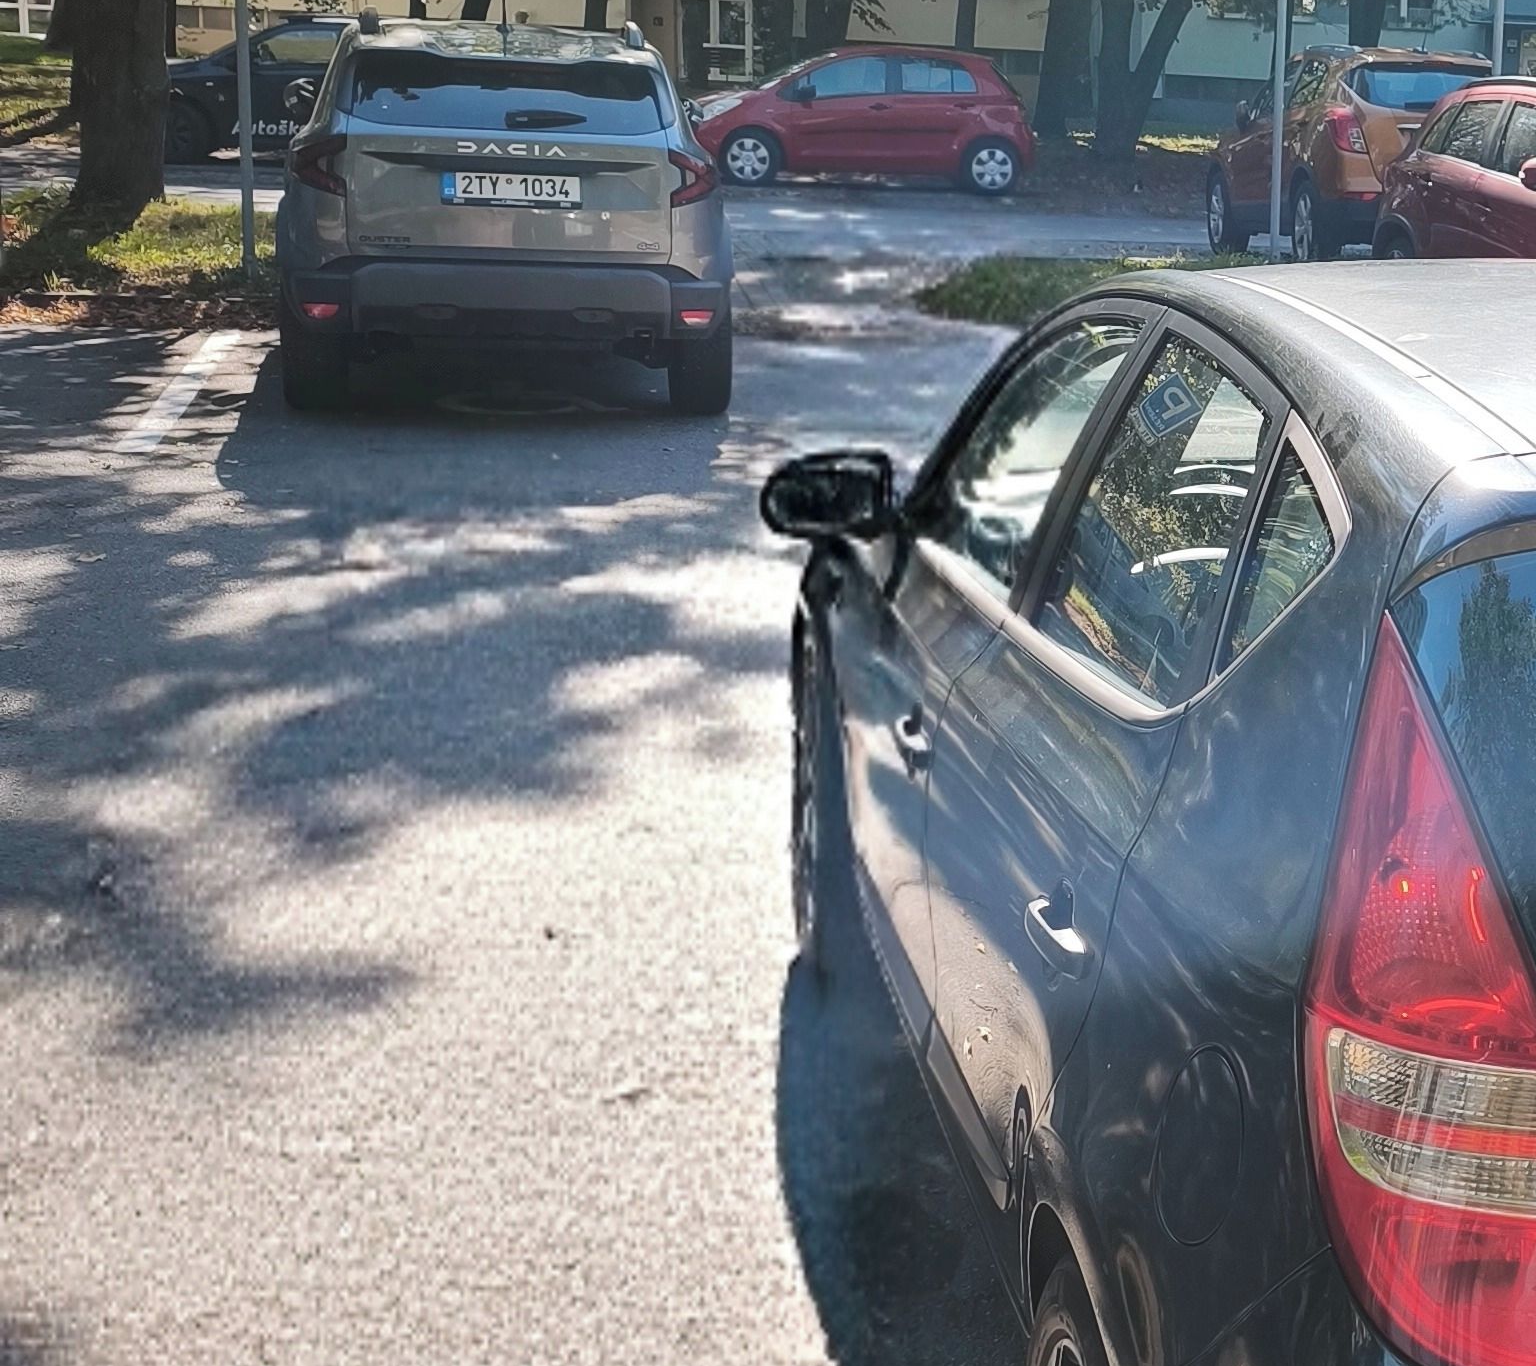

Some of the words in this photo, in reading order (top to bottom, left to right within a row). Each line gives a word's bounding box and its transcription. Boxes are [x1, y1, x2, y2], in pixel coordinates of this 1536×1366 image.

[457, 141, 567, 157] DACIA
[461, 175, 499, 195] 2TY
[520, 178, 570, 198] 1034
